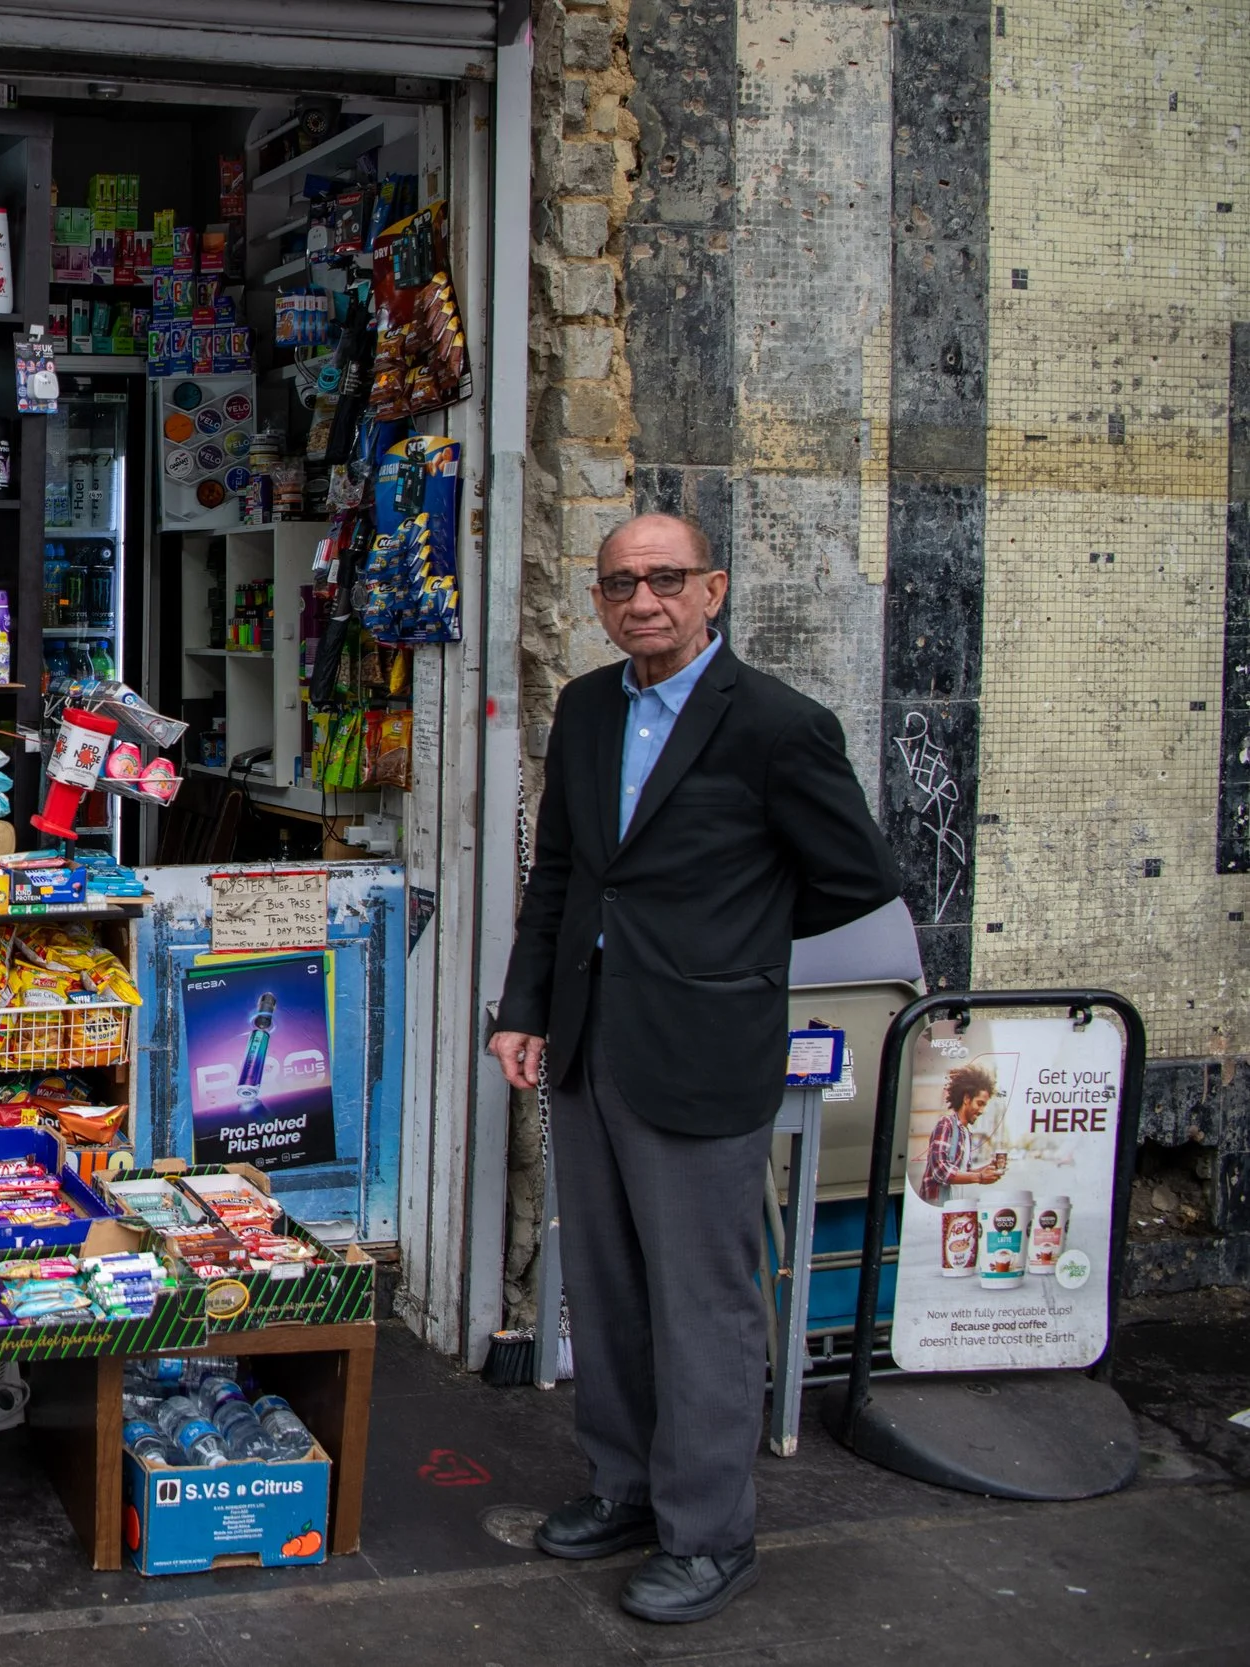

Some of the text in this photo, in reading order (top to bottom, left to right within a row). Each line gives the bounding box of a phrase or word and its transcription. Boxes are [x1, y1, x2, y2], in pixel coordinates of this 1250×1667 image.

[41, 344, 53, 353] UK
[226, 404, 250, 412] VELO
[200, 414, 221, 429] VELO
[200, 451, 221, 465] VELO
[74, 479, 84, 510] Huel
[75, 759, 95, 770] DAY
[221, 879, 265, 896] OYSTER
[288, 898, 310, 908] PASS
[264, 914, 316, 923] TRAIN PASS
[296, 926, 317, 934] PASS
[283, 1061, 326, 1076] PLUS
[1038, 1068, 1111, 1088] Get your
[1026, 1087, 1109, 1105] favourites
[219, 1114, 307, 1140] Pro Evolved
[1030, 1108, 1107, 1133] HERE
[228, 1132, 301, 1154] Plus More
[927, 1305, 1073, 1320] Now with fully recyclable cups!
[951, 1320, 1047, 1332] Because good coffee
[919, 1332, 1077, 1347] doesn't have to cost the Earth.
[251, 1479, 303, 1496] Citrus
